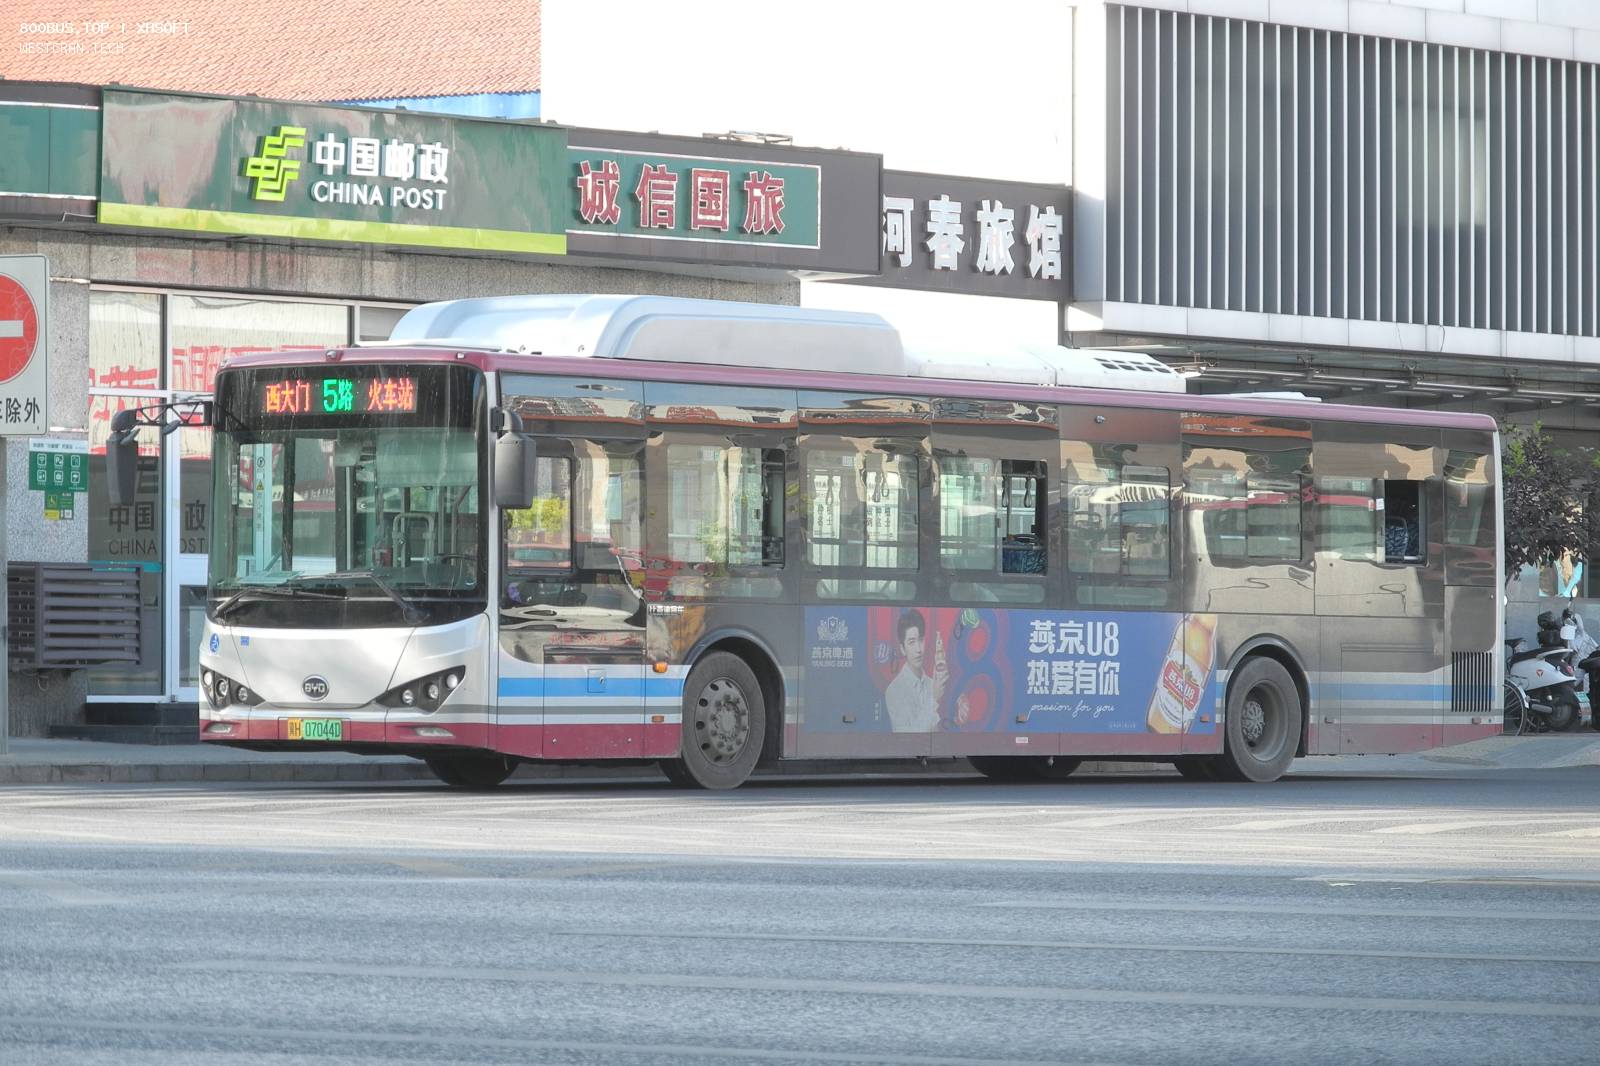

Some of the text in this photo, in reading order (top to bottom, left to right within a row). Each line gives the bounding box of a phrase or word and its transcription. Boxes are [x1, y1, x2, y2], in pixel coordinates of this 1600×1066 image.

[314, 132, 449, 184] 中国邮政
[312, 181, 448, 210] CHINA POST
[577, 159, 786, 236] 诚信国旅
[0, 397, 40, 425] 除外
[265, 377, 414, 414] 西大门 5路 火车站
[108, 538, 205, 555] CHINA OST
[1028, 619, 1120, 657] 燕京U8
[304, 682, 326, 693] BYD
[1026, 659, 1121, 696] 热爱有你
[1071, 699, 1093, 719] for
[1093, 704, 1116, 719] you
